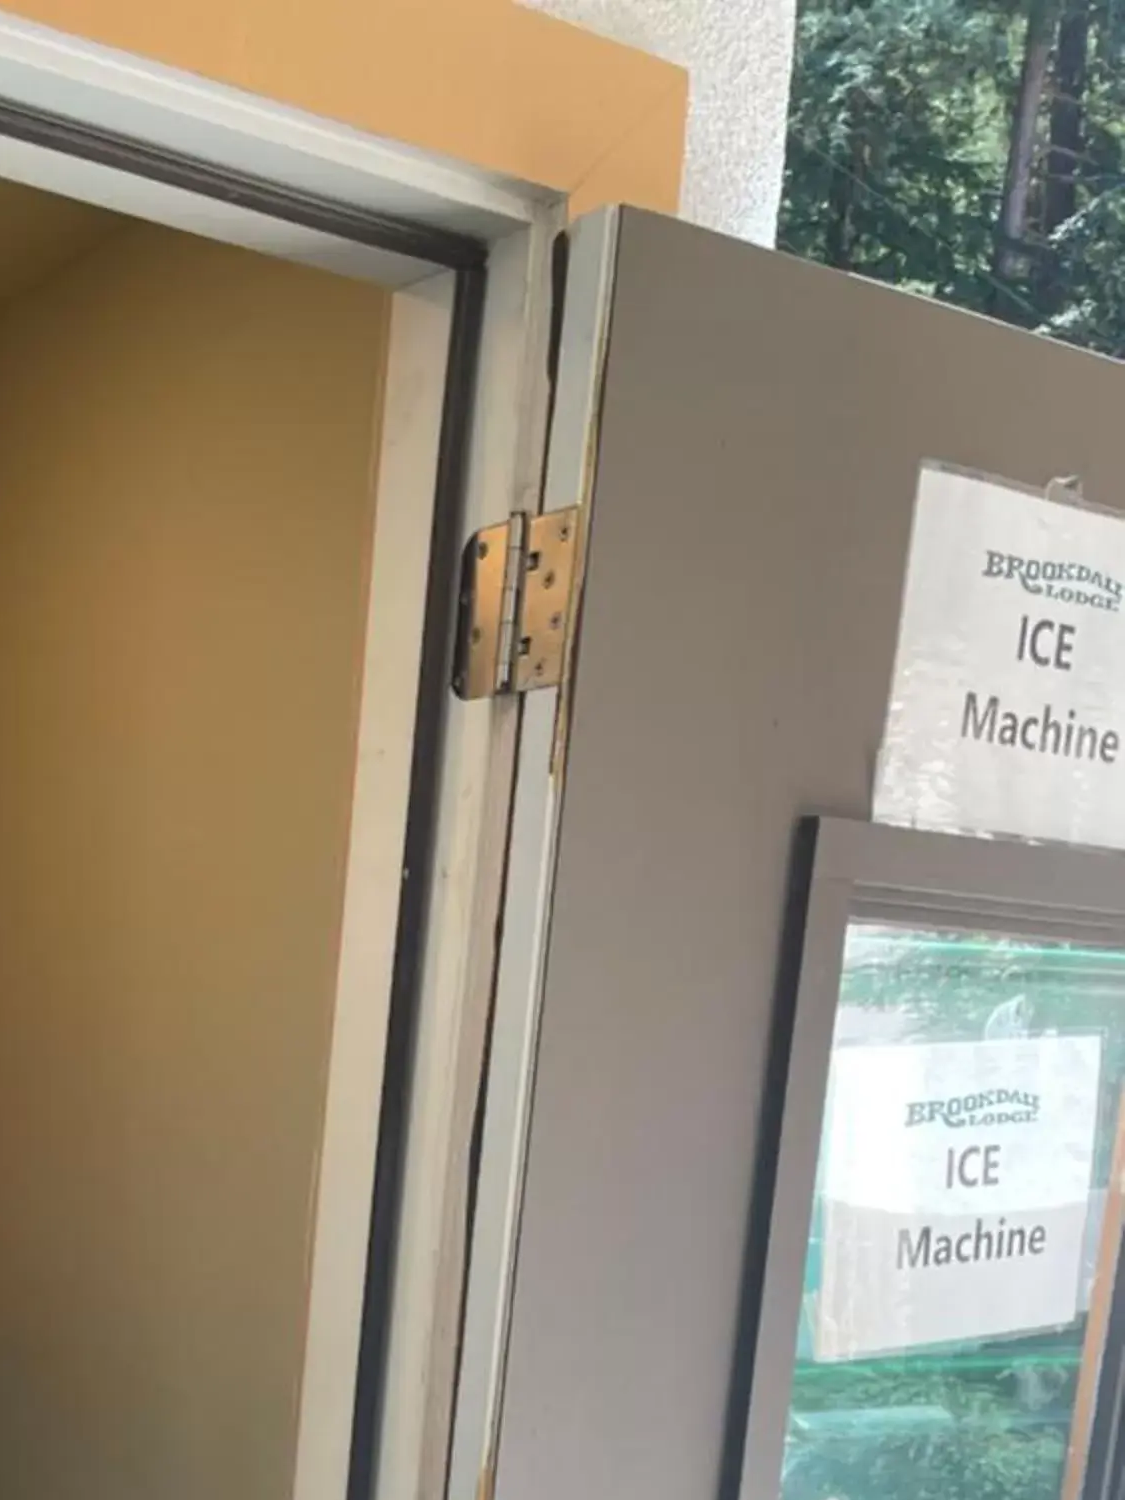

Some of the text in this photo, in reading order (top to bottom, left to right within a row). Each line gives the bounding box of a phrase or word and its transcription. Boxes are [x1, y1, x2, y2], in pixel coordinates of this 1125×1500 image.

[1016, 615, 1076, 671] ICE
[961, 691, 1119, 763] Machine
[946, 1145, 1001, 1189] ICE
[896, 1216, 1046, 1270] Machine
